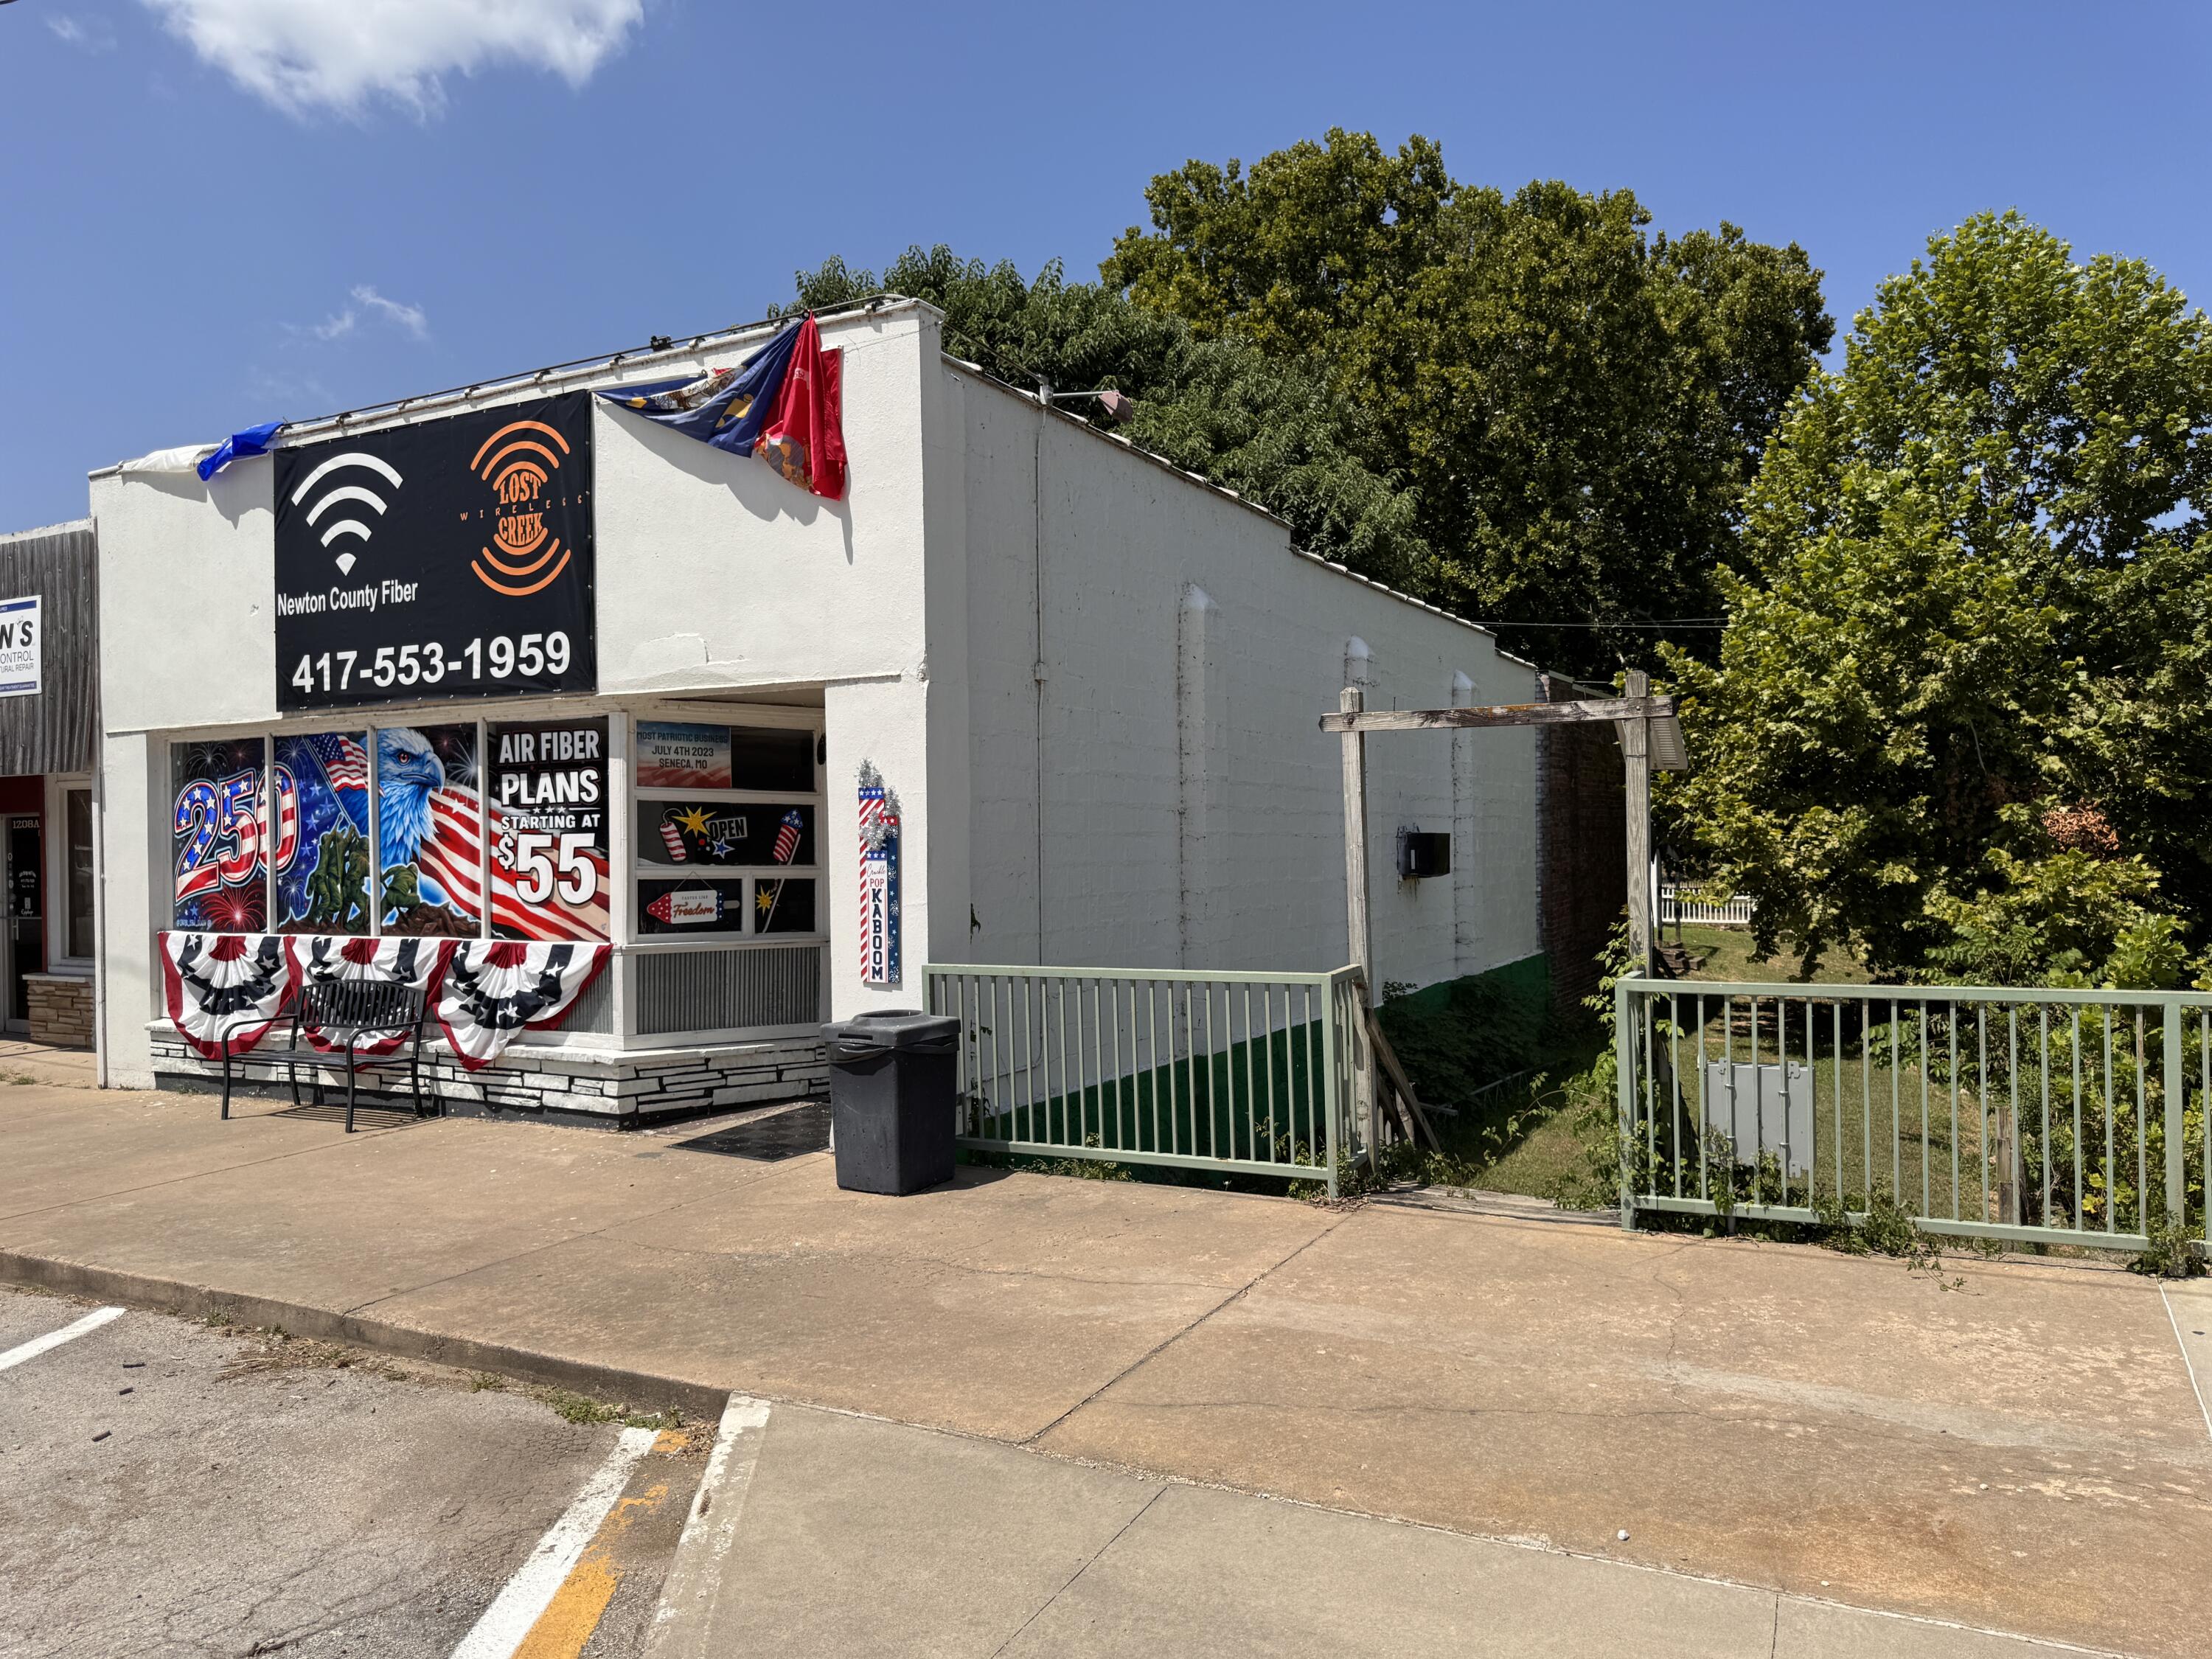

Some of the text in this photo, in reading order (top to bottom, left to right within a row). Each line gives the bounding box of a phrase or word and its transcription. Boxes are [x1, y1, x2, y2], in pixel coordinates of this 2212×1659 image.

[499, 470, 541, 504] LOST
[460, 495, 582, 521] WIRELESS
[498, 512, 543, 546] CREEK
[277, 579, 418, 616] Newton County Fiber
[15, 663, 34, 671] REPAIR
[292, 631, 571, 693] 417-553-1959
[499, 730, 599, 764] AIR FIBER
[636, 731, 728, 744] MOST PATRIOTIC BUSINESS
[652, 745, 714, 757] JULY 4TH 2023
[659, 758, 708, 769] SENECA, MO
[501, 769, 599, 806] PLANS
[13, 819, 40, 829] 1208A
[175, 762, 299, 905] 250
[501, 813, 601, 831] STARTING AT
[709, 818, 744, 840] OPEN
[498, 832, 597, 905] $55
[870, 878, 885, 887] POP
[673, 902, 714, 918] Freedom
[872, 888, 883, 981] KABOOM
